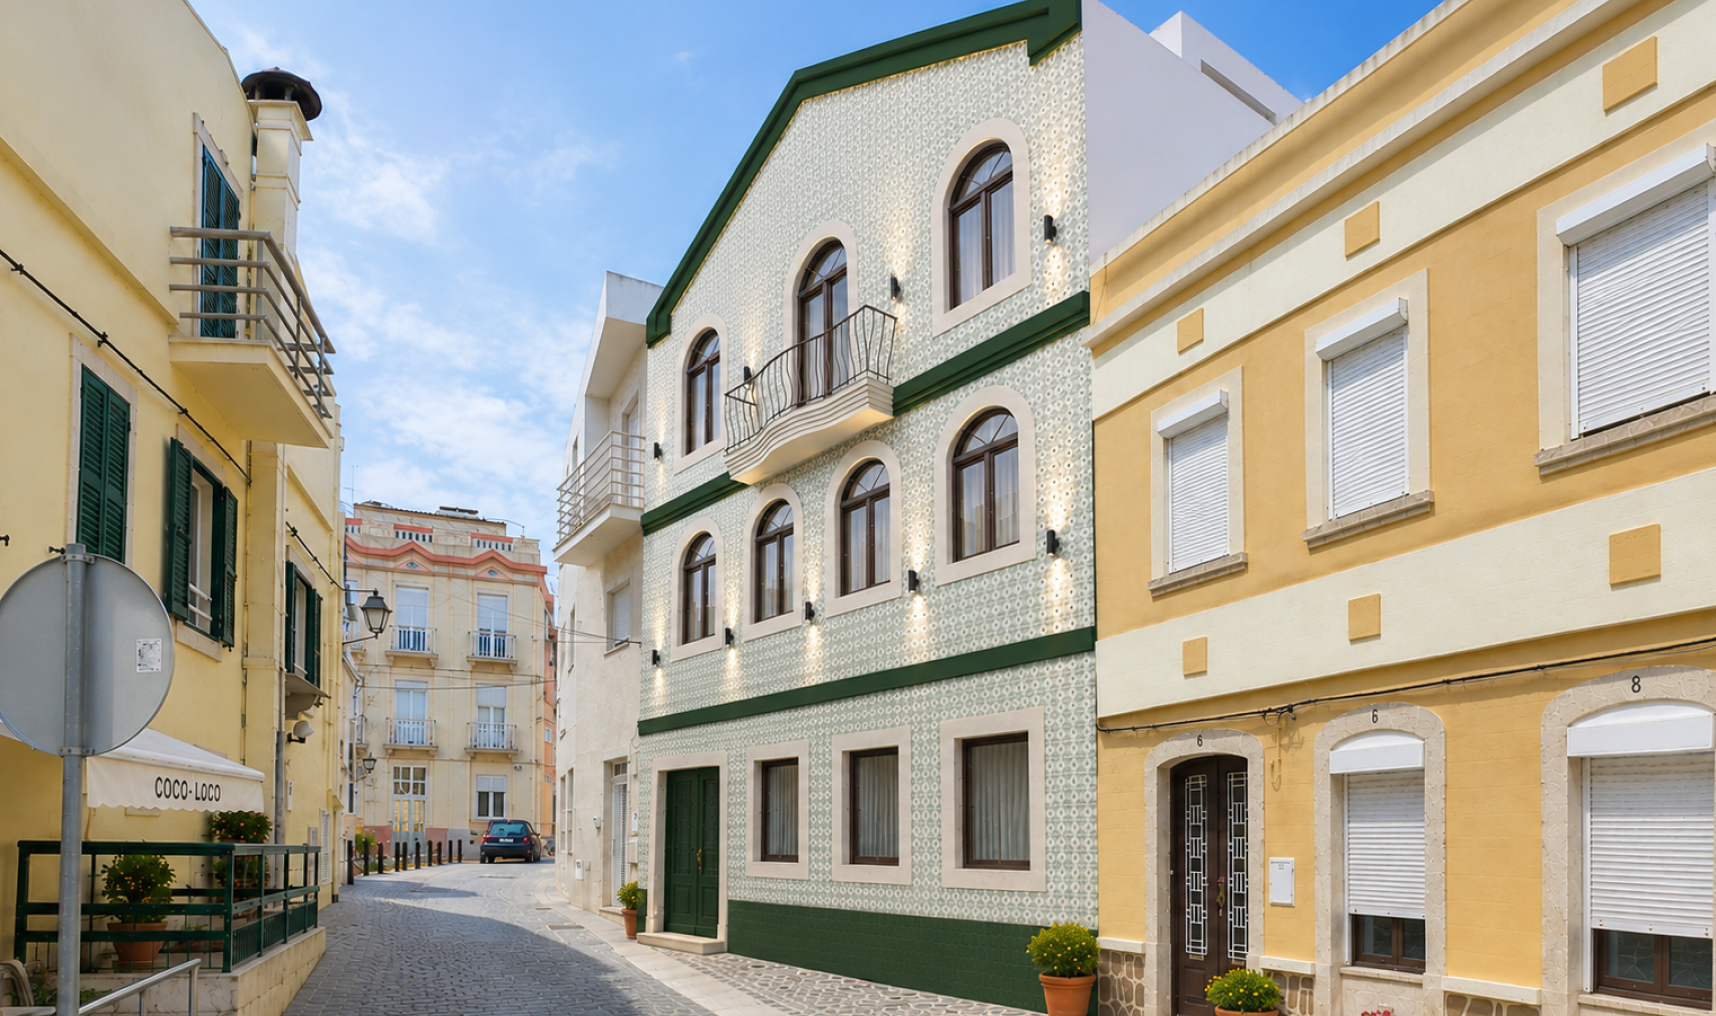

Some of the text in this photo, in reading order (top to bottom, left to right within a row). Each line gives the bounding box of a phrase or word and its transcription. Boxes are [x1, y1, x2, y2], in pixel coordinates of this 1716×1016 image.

[1631, 675, 1641, 693] 8
[1372, 708, 1379, 723] 6
[1197, 734, 1203, 747] 6
